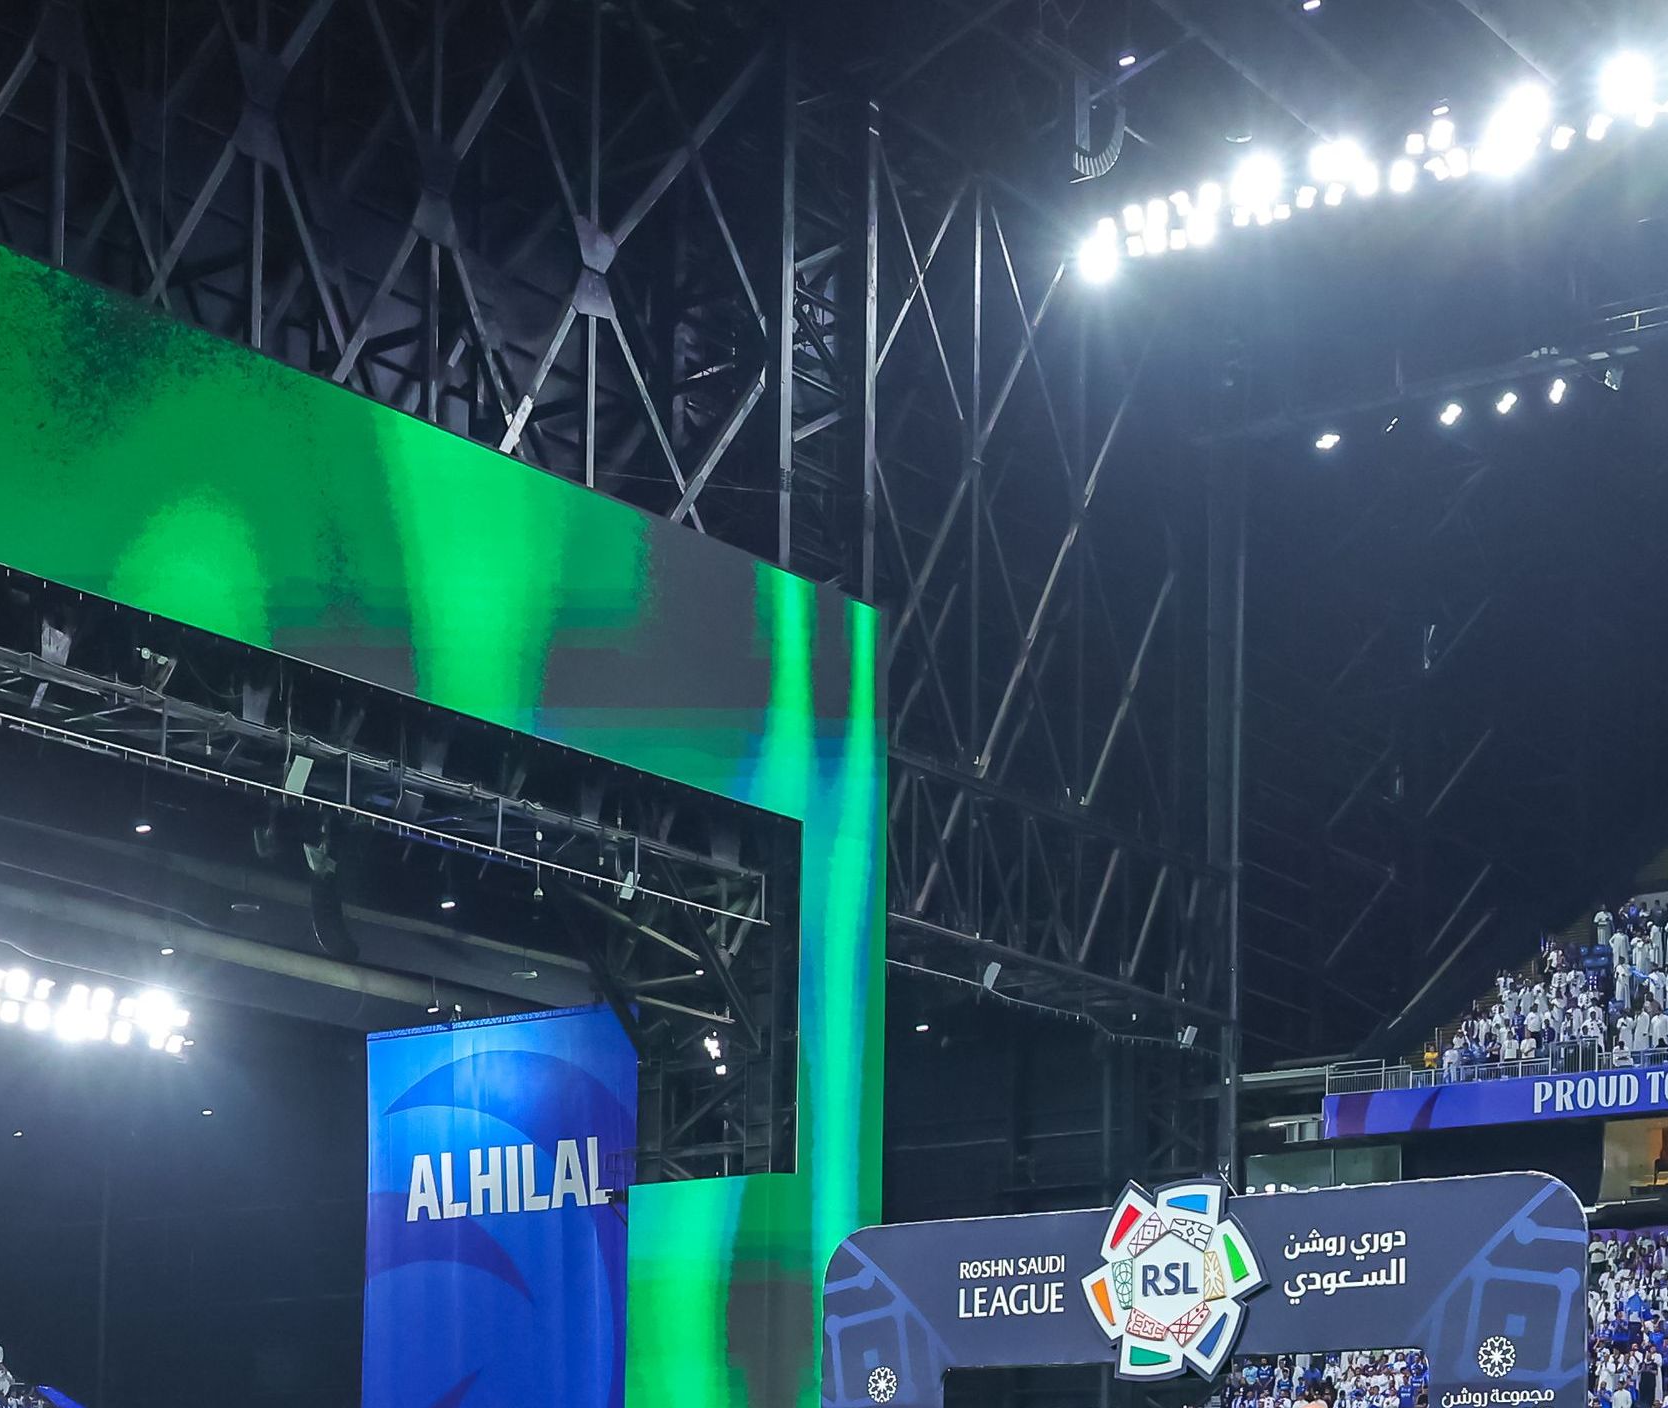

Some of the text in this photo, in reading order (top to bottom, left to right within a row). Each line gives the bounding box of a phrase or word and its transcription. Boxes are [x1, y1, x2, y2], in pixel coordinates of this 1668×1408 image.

[1533, 1073, 1639, 1114] PROUD
[406, 1136, 614, 1222] ALHILAL
[1284, 1230, 1407, 1262] دوري روشن
[959, 1255, 1066, 1280] ROSHN SAUDI
[1141, 1262, 1199, 1297] RSL
[1284, 1260, 1407, 1305] السعودي
[958, 1281, 1065, 1319] LEAGUE
[1441, 1387, 1555, 1408] مجموعة روشن
